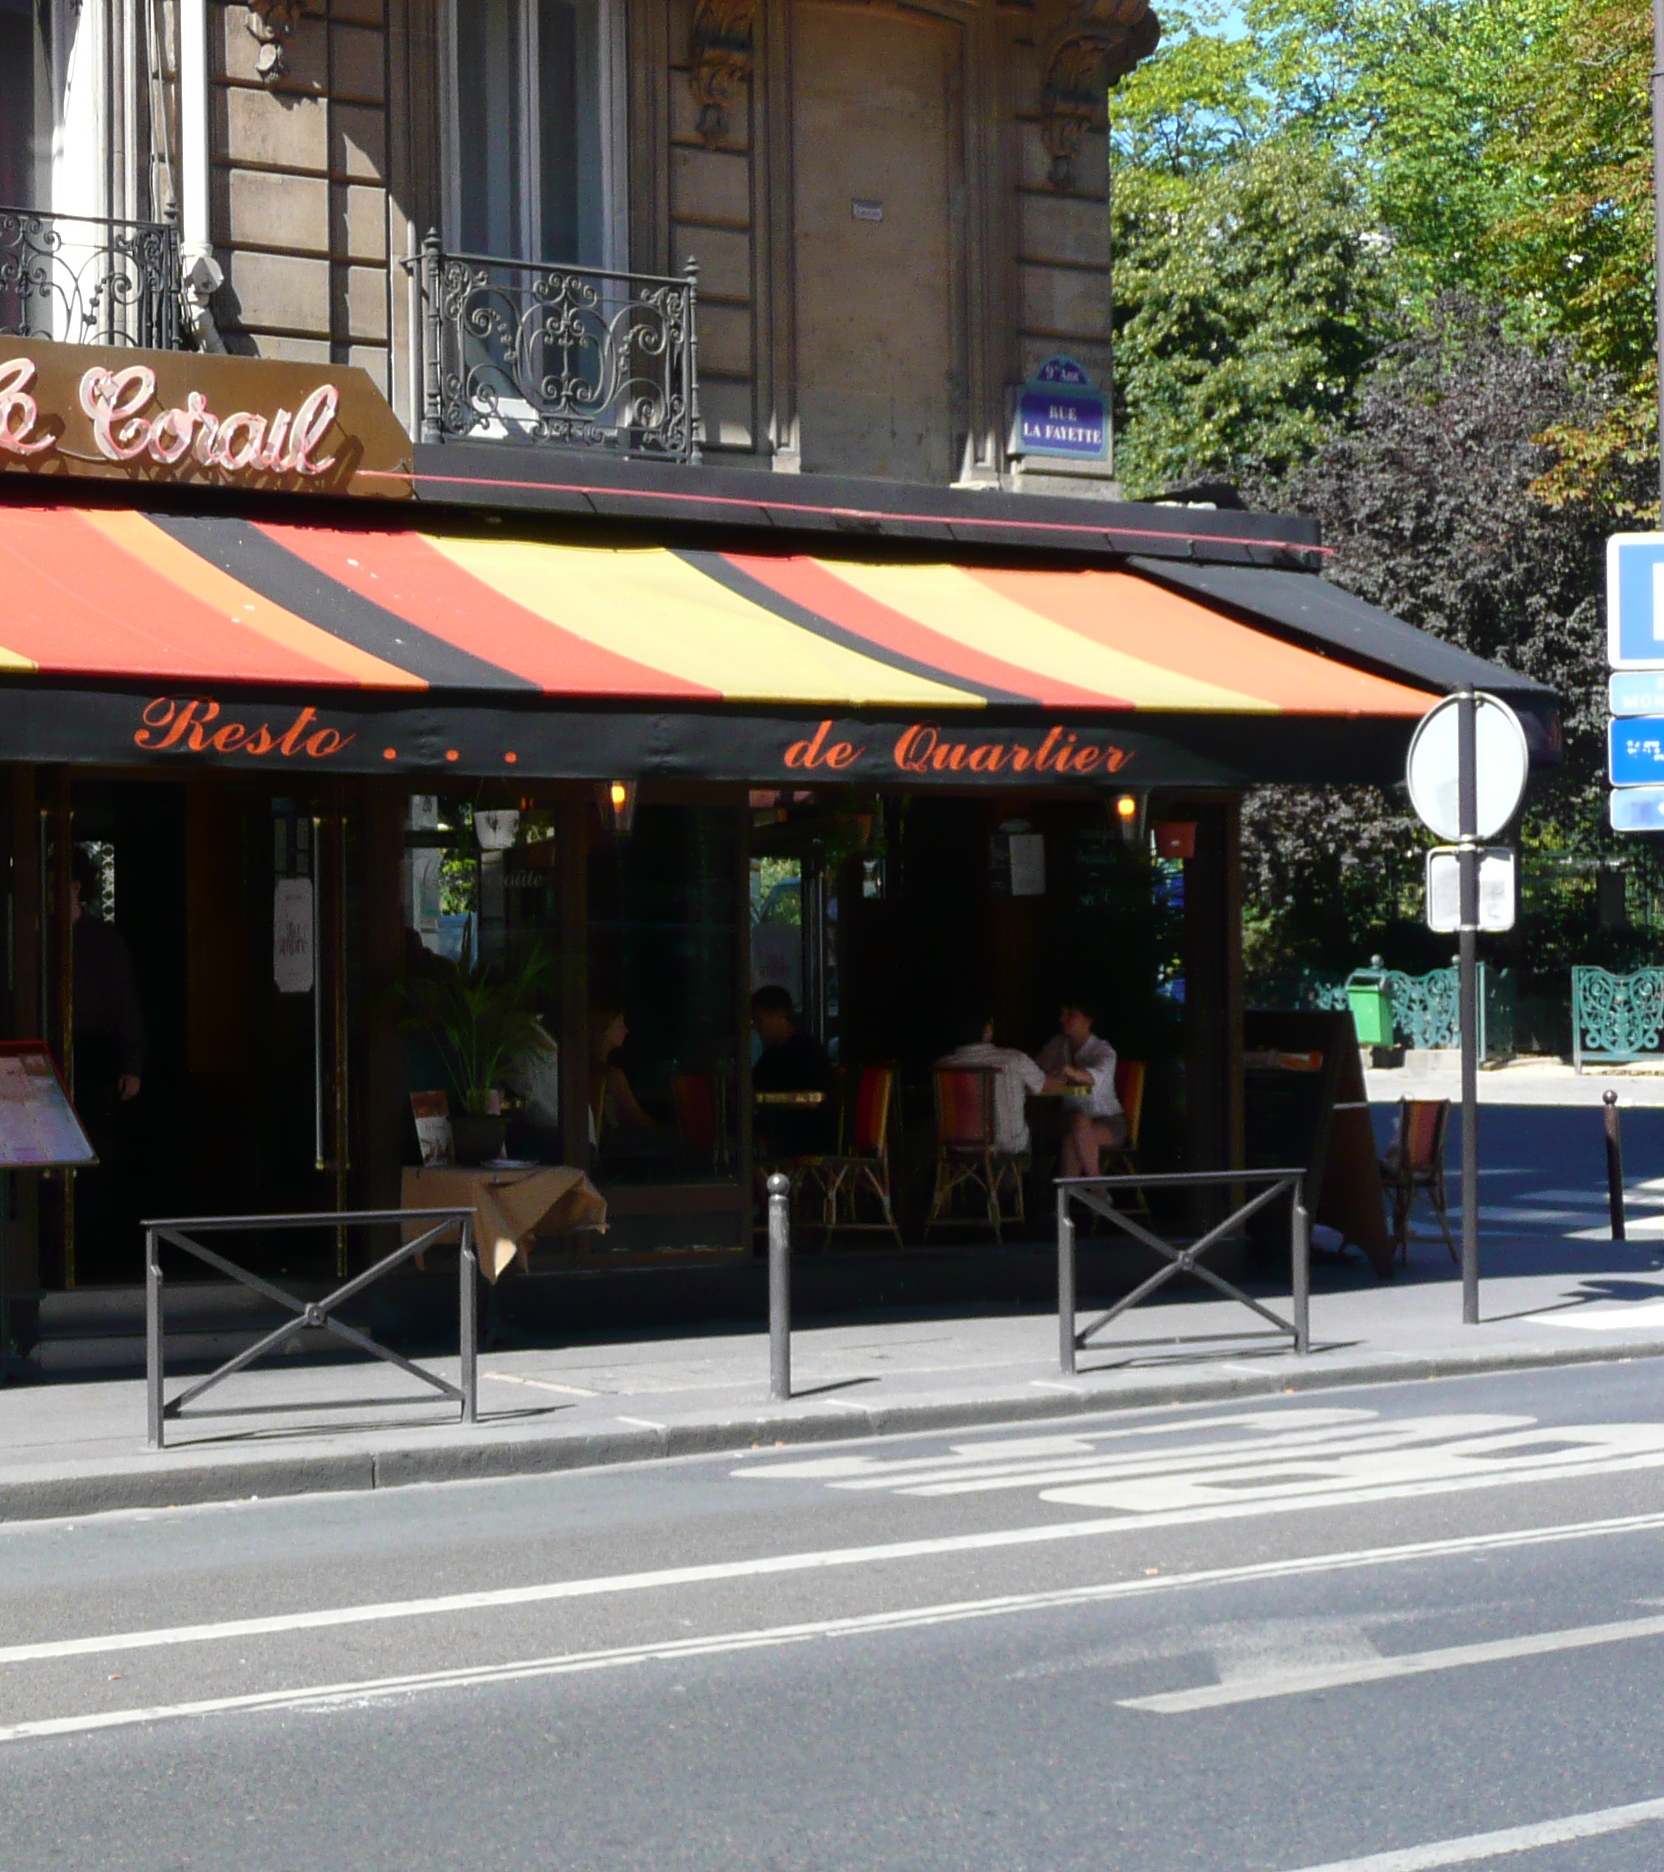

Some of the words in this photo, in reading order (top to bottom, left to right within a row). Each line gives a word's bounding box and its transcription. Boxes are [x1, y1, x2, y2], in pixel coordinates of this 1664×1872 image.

[79, 365, 338, 474] Corail
[1023, 422, 1042, 438] LA
[1045, 425, 1102, 444] FAYETTE
[1049, 405, 1077, 421] RUE
[133, 693, 357, 758] Resto
[783, 719, 865, 770] de
[893, 719, 1136, 775] Quartier
